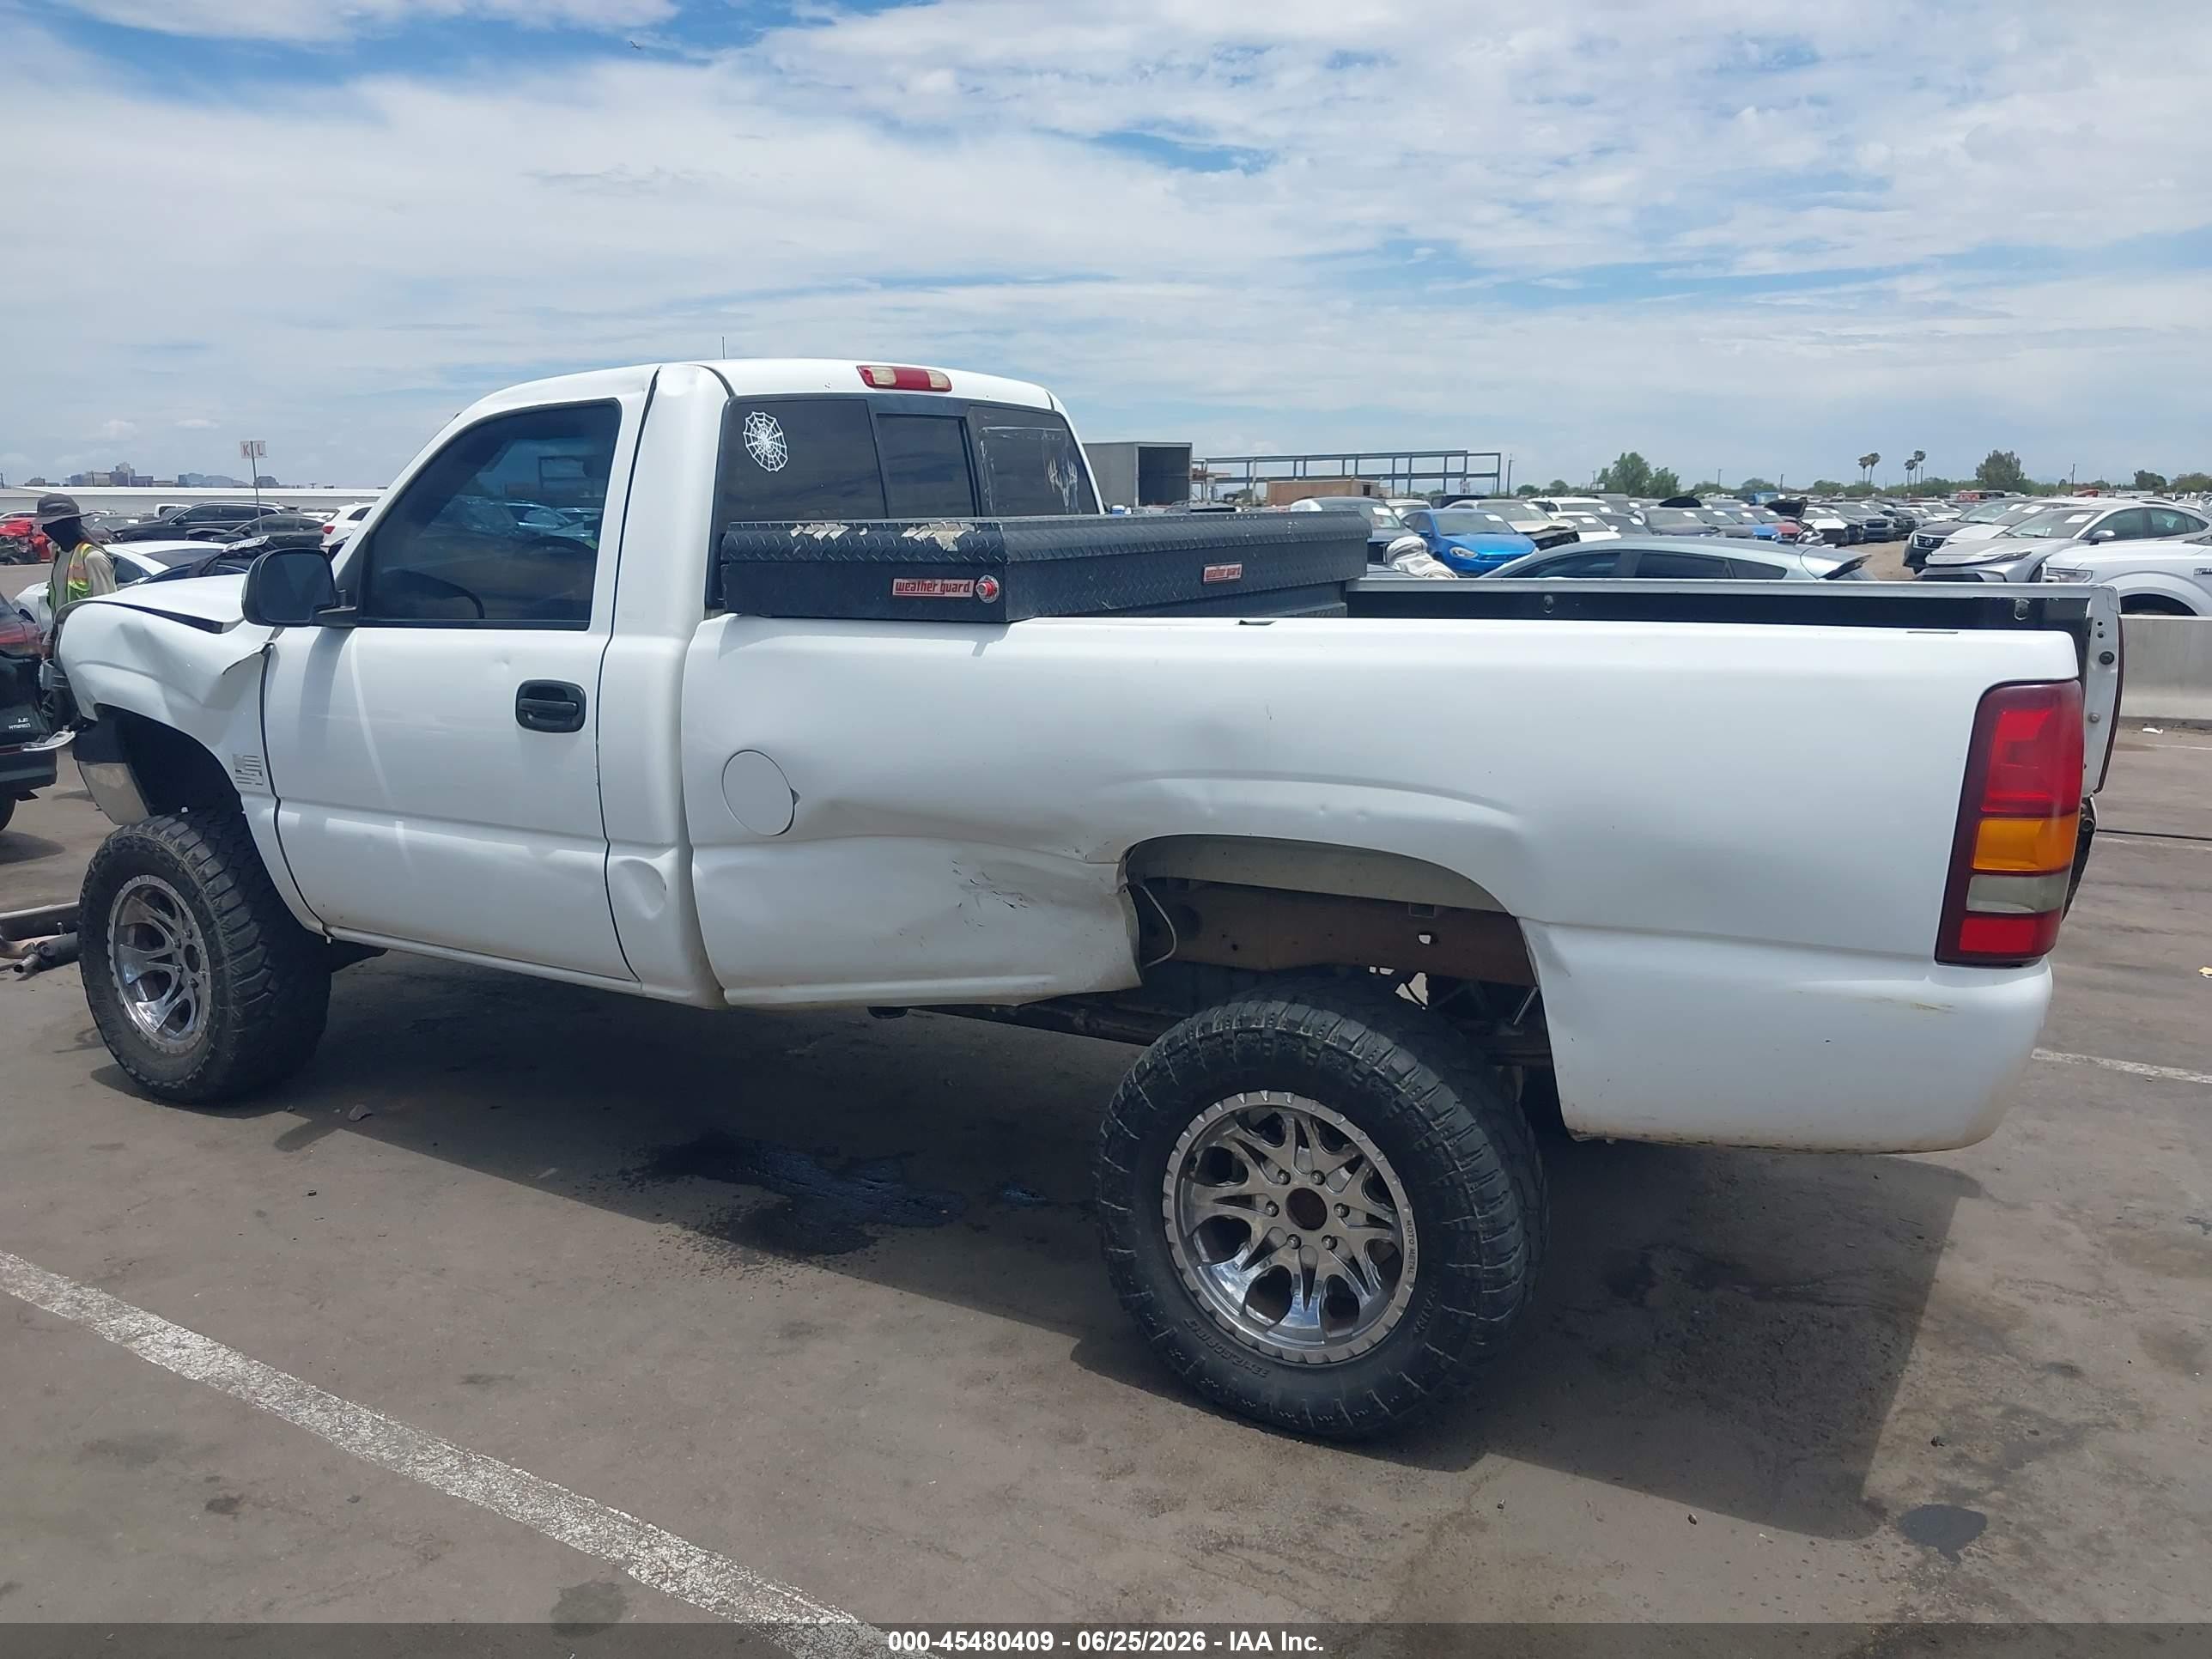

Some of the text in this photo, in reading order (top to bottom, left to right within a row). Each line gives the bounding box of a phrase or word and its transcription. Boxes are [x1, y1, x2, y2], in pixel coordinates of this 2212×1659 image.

[242, 443, 264, 456] K L
[895, 580, 971, 594] weather guard
[1407, 1219, 1416, 1275] MOTO METAL
